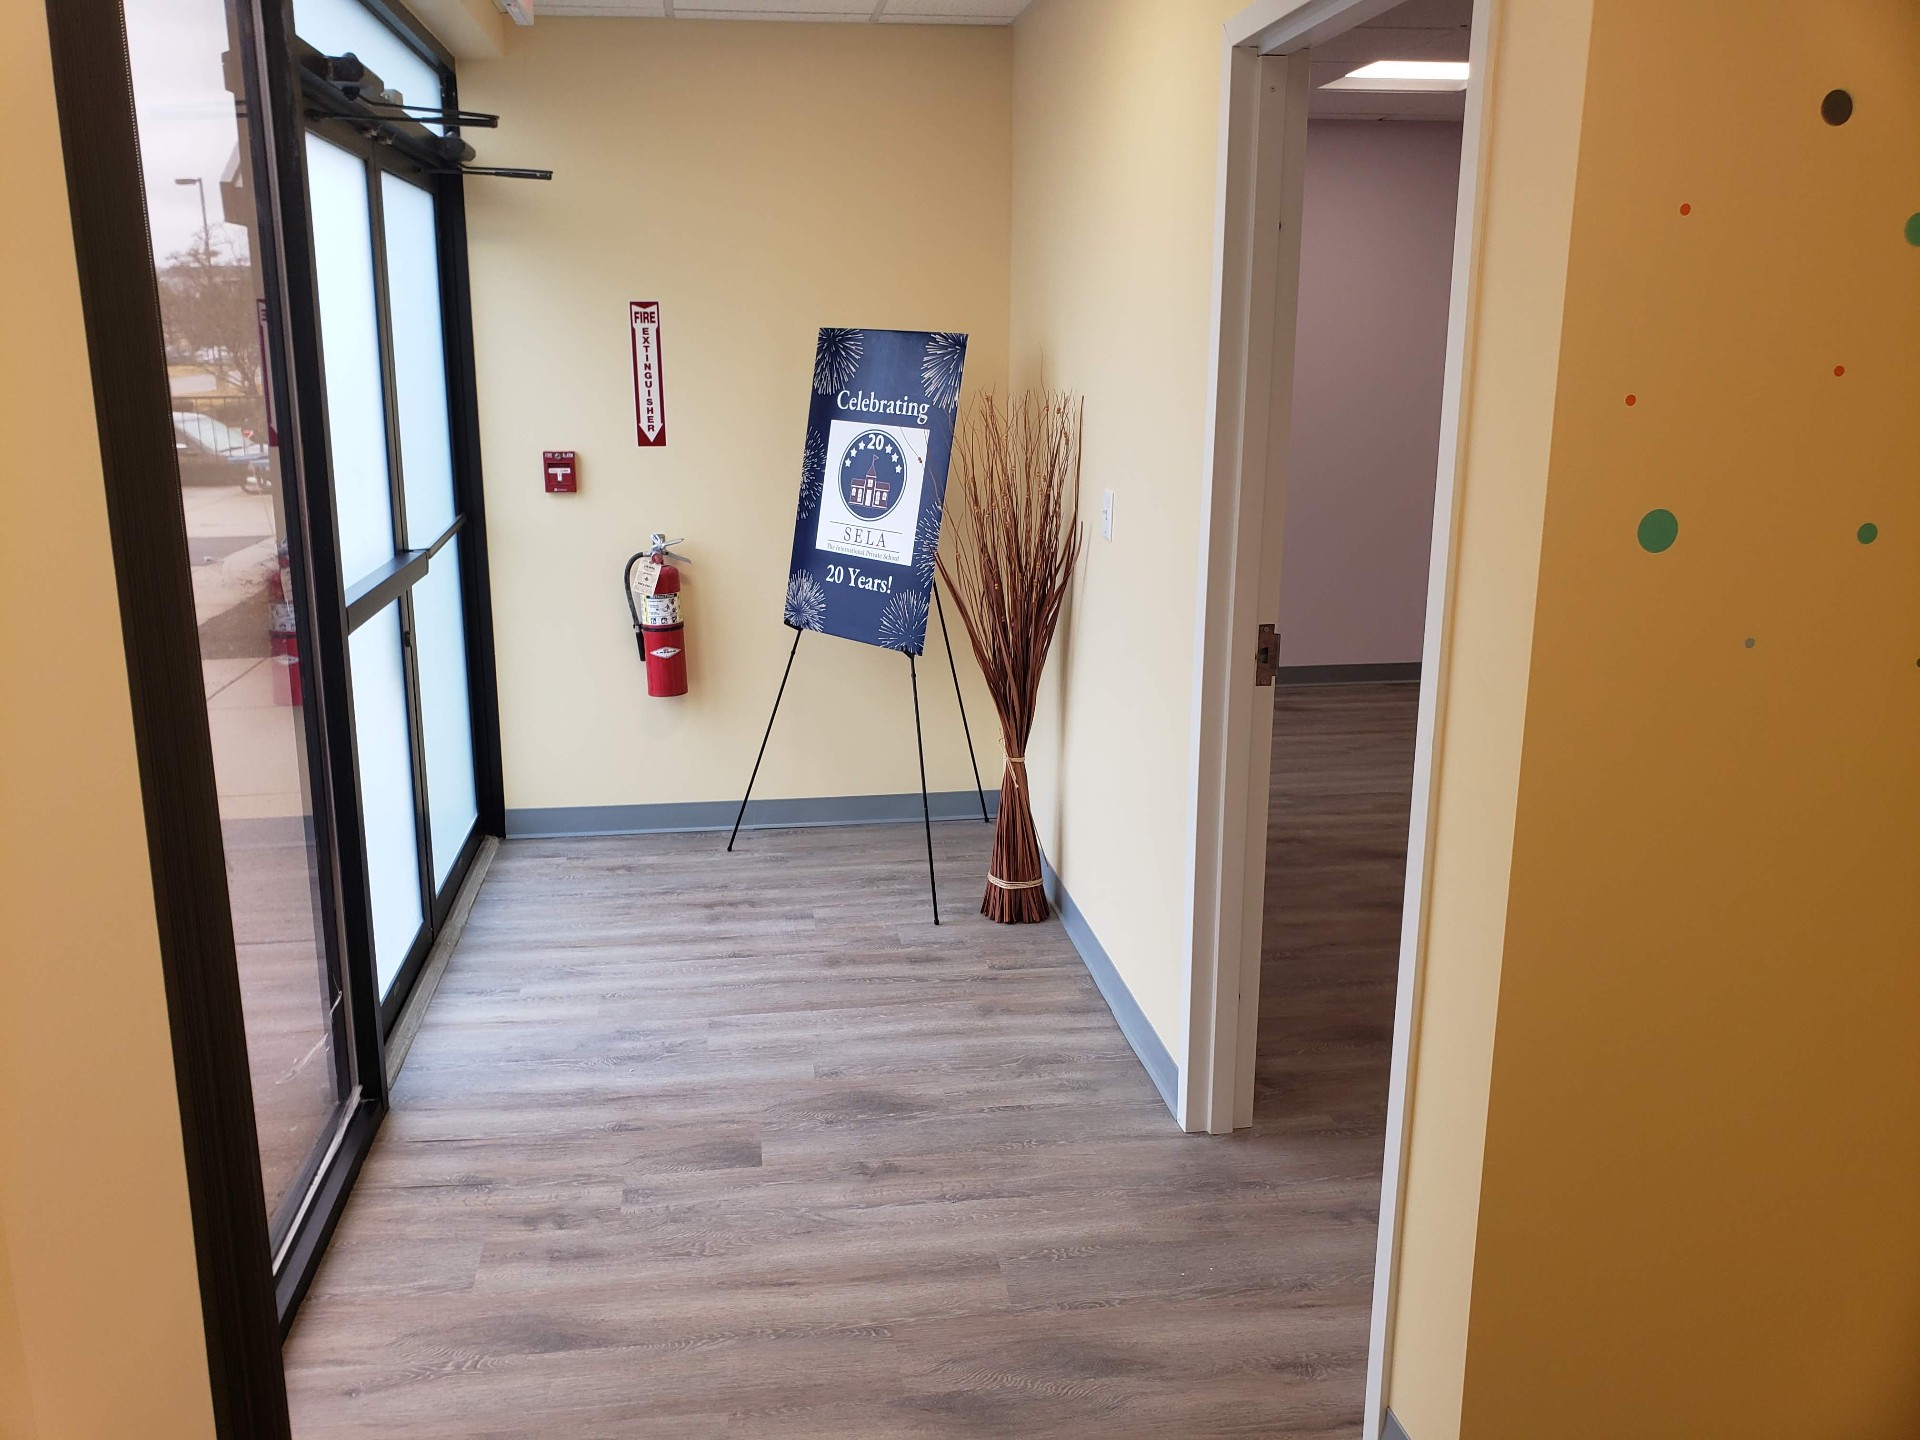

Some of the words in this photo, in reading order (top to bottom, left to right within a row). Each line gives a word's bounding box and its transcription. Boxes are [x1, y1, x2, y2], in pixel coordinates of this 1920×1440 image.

[634, 311, 656, 324] FIRE
[642, 327, 655, 432] EXTINGUISHER
[836, 389, 931, 424] Celebrating
[867, 434, 885, 451] 20
[843, 526, 887, 548] SELA
[835, 544, 865, 556] International
[865, 550, 882, 560] Private
[882, 553, 900, 562] School
[825, 564, 844, 584] 20
[848, 567, 893, 594] Years!
